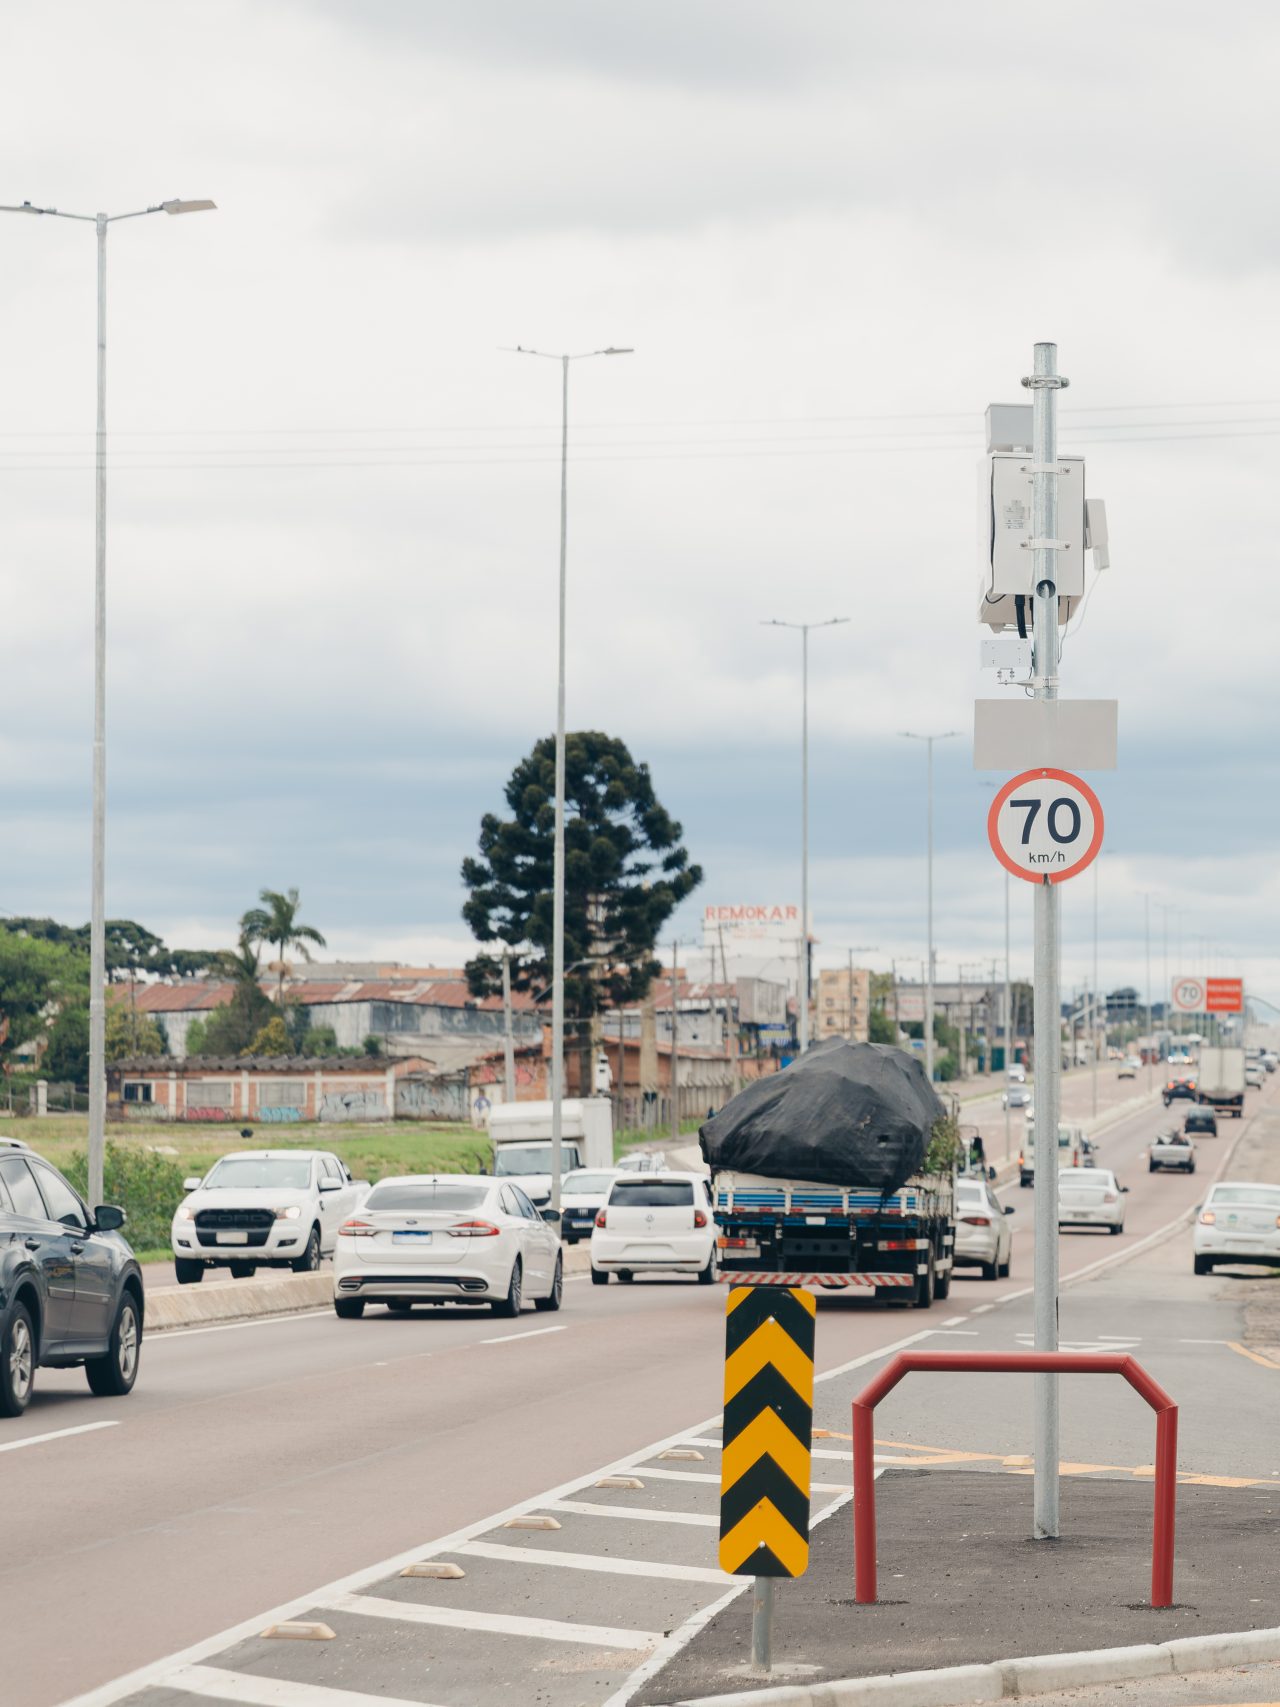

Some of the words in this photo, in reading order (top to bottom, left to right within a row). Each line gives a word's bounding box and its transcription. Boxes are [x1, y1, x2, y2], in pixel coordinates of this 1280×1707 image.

[1010, 798, 1081, 845] 70
[1029, 851, 1065, 863] km/h
[705, 905, 798, 920] REMOKAR
[1182, 987, 1198, 998] 70
